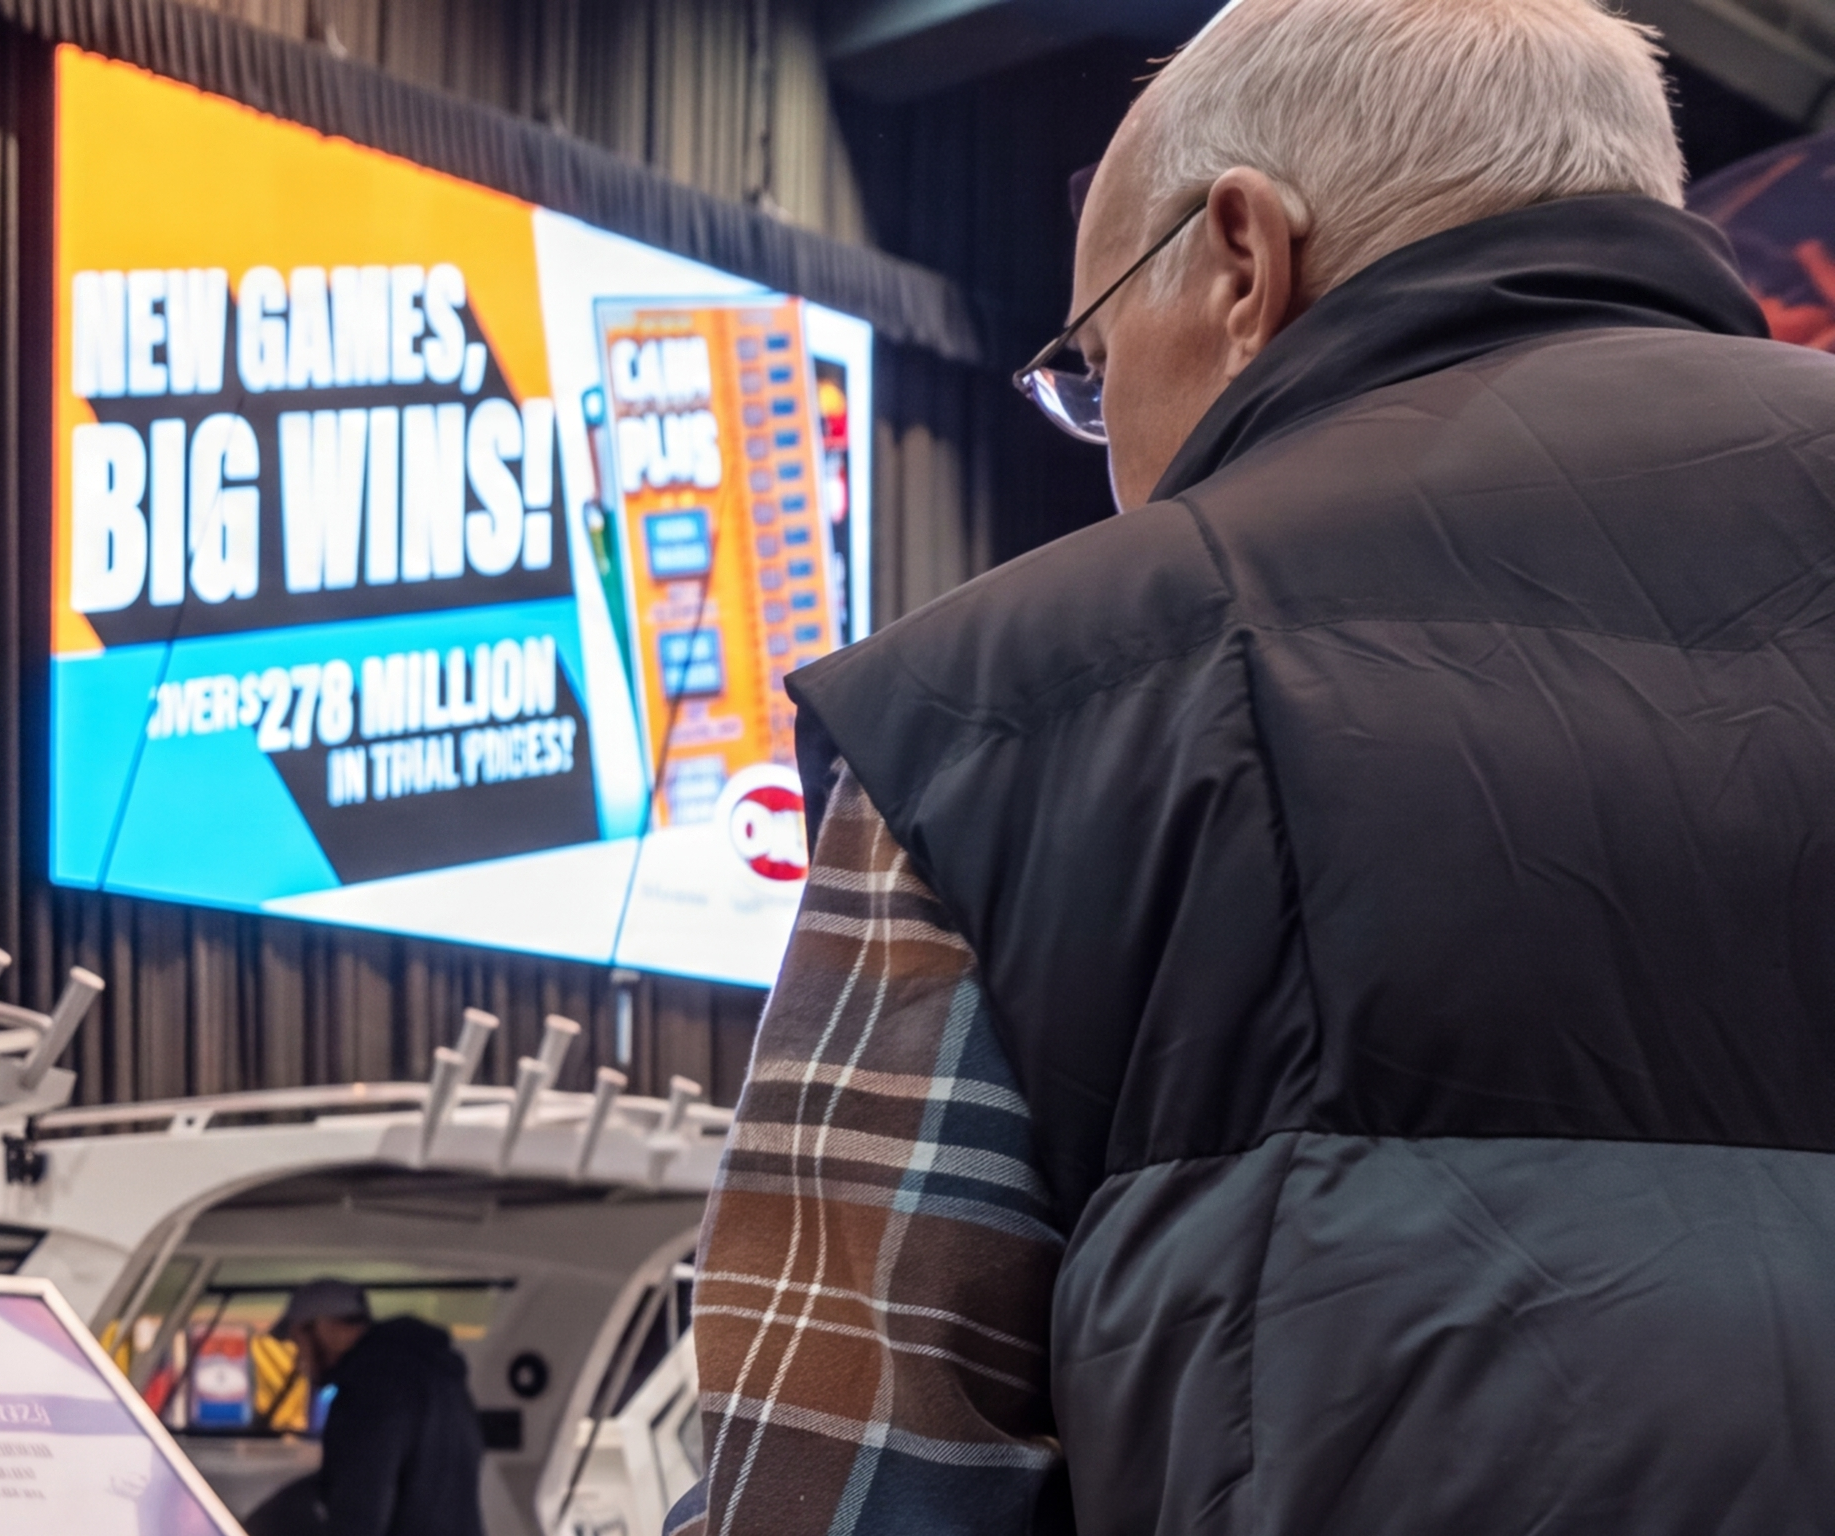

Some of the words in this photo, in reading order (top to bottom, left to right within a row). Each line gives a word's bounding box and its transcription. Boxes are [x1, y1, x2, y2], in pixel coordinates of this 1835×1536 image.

[71, 267, 229, 398] NEW
[237, 263, 487, 394] GAMES,
[70, 411, 260, 613] BIG
[277, 397, 554, 594] WINS!
[359, 634, 557, 740] MILLION
[327, 746, 367, 807] IN
